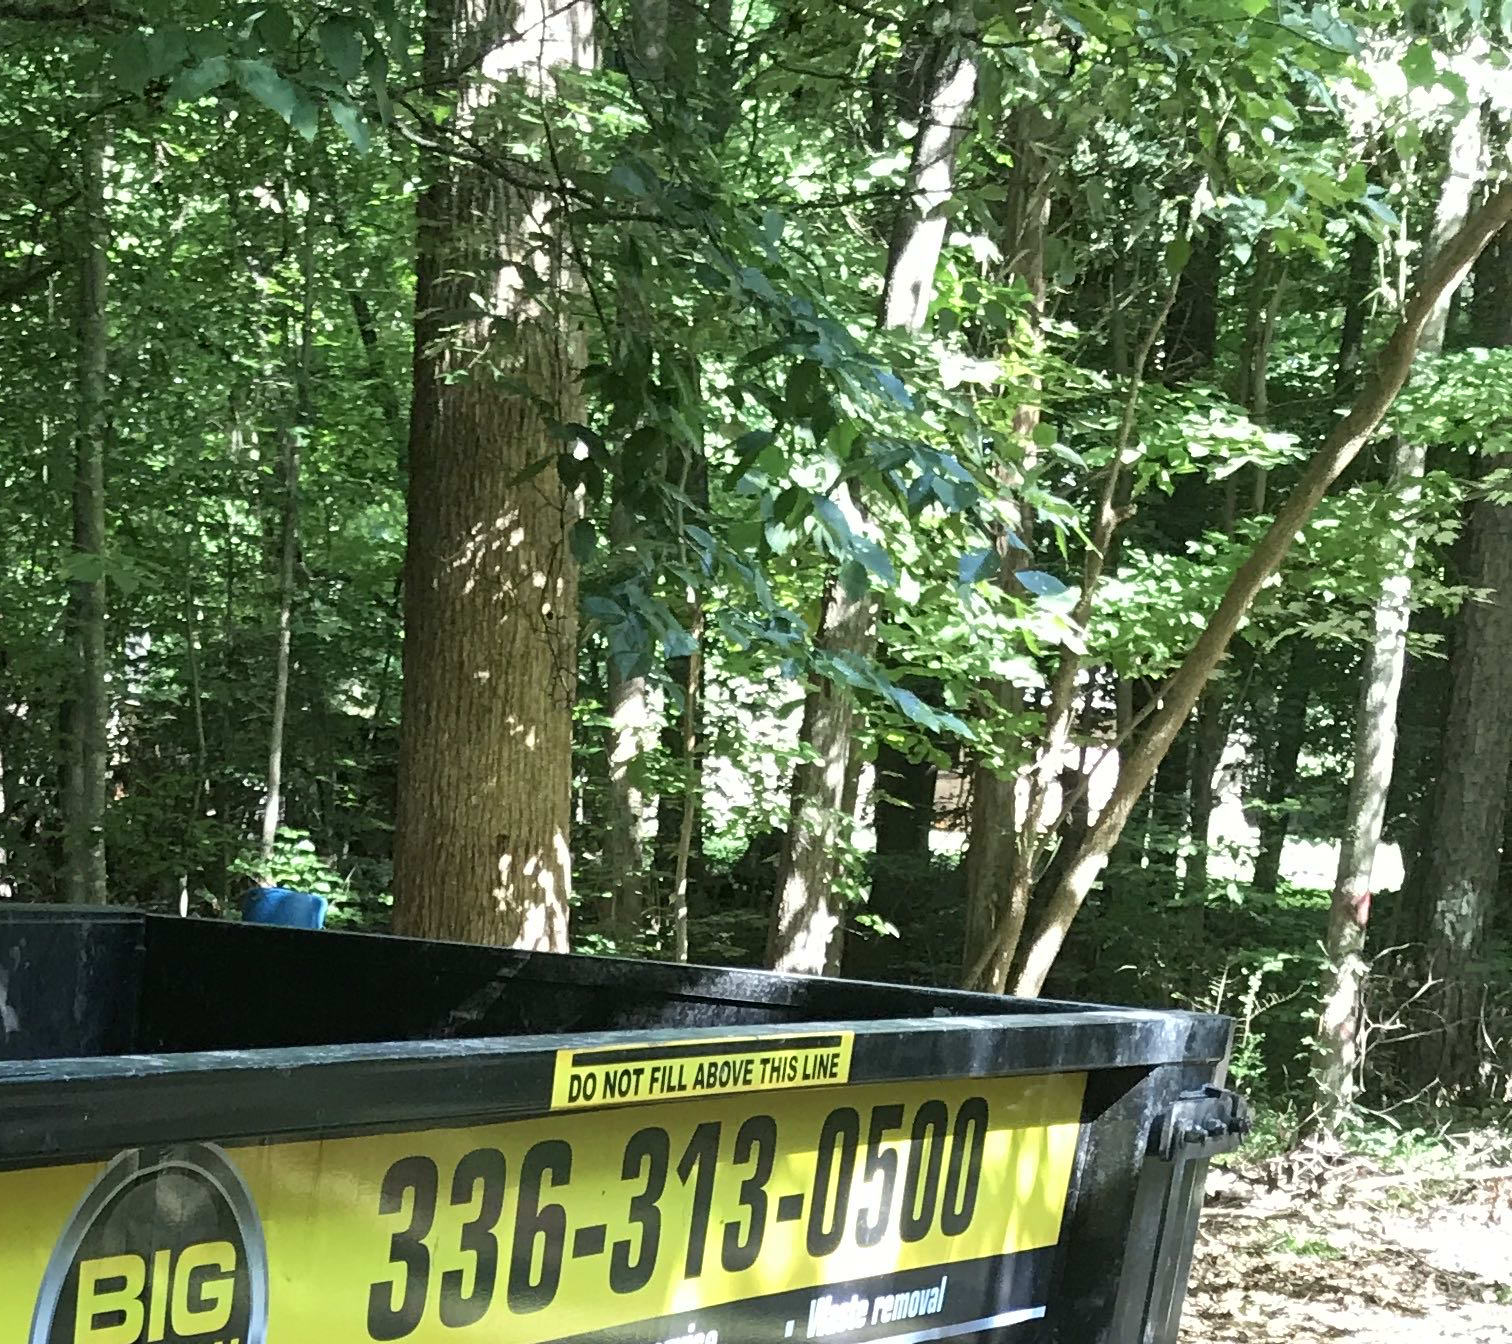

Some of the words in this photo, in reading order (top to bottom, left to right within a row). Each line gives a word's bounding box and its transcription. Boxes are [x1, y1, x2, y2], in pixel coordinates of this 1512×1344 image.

[568, 1072, 596, 1103] DO
[602, 1068, 644, 1099] NOT
[649, 1064, 688, 1094] FILL
[693, 1059, 754, 1089] ABOVE
[760, 1055, 798, 1084] THIS
[802, 1053, 841, 1080] LINE
[367, 1096, 990, 1342] 336-313-0500
[871, 1276, 947, 1325] removal
